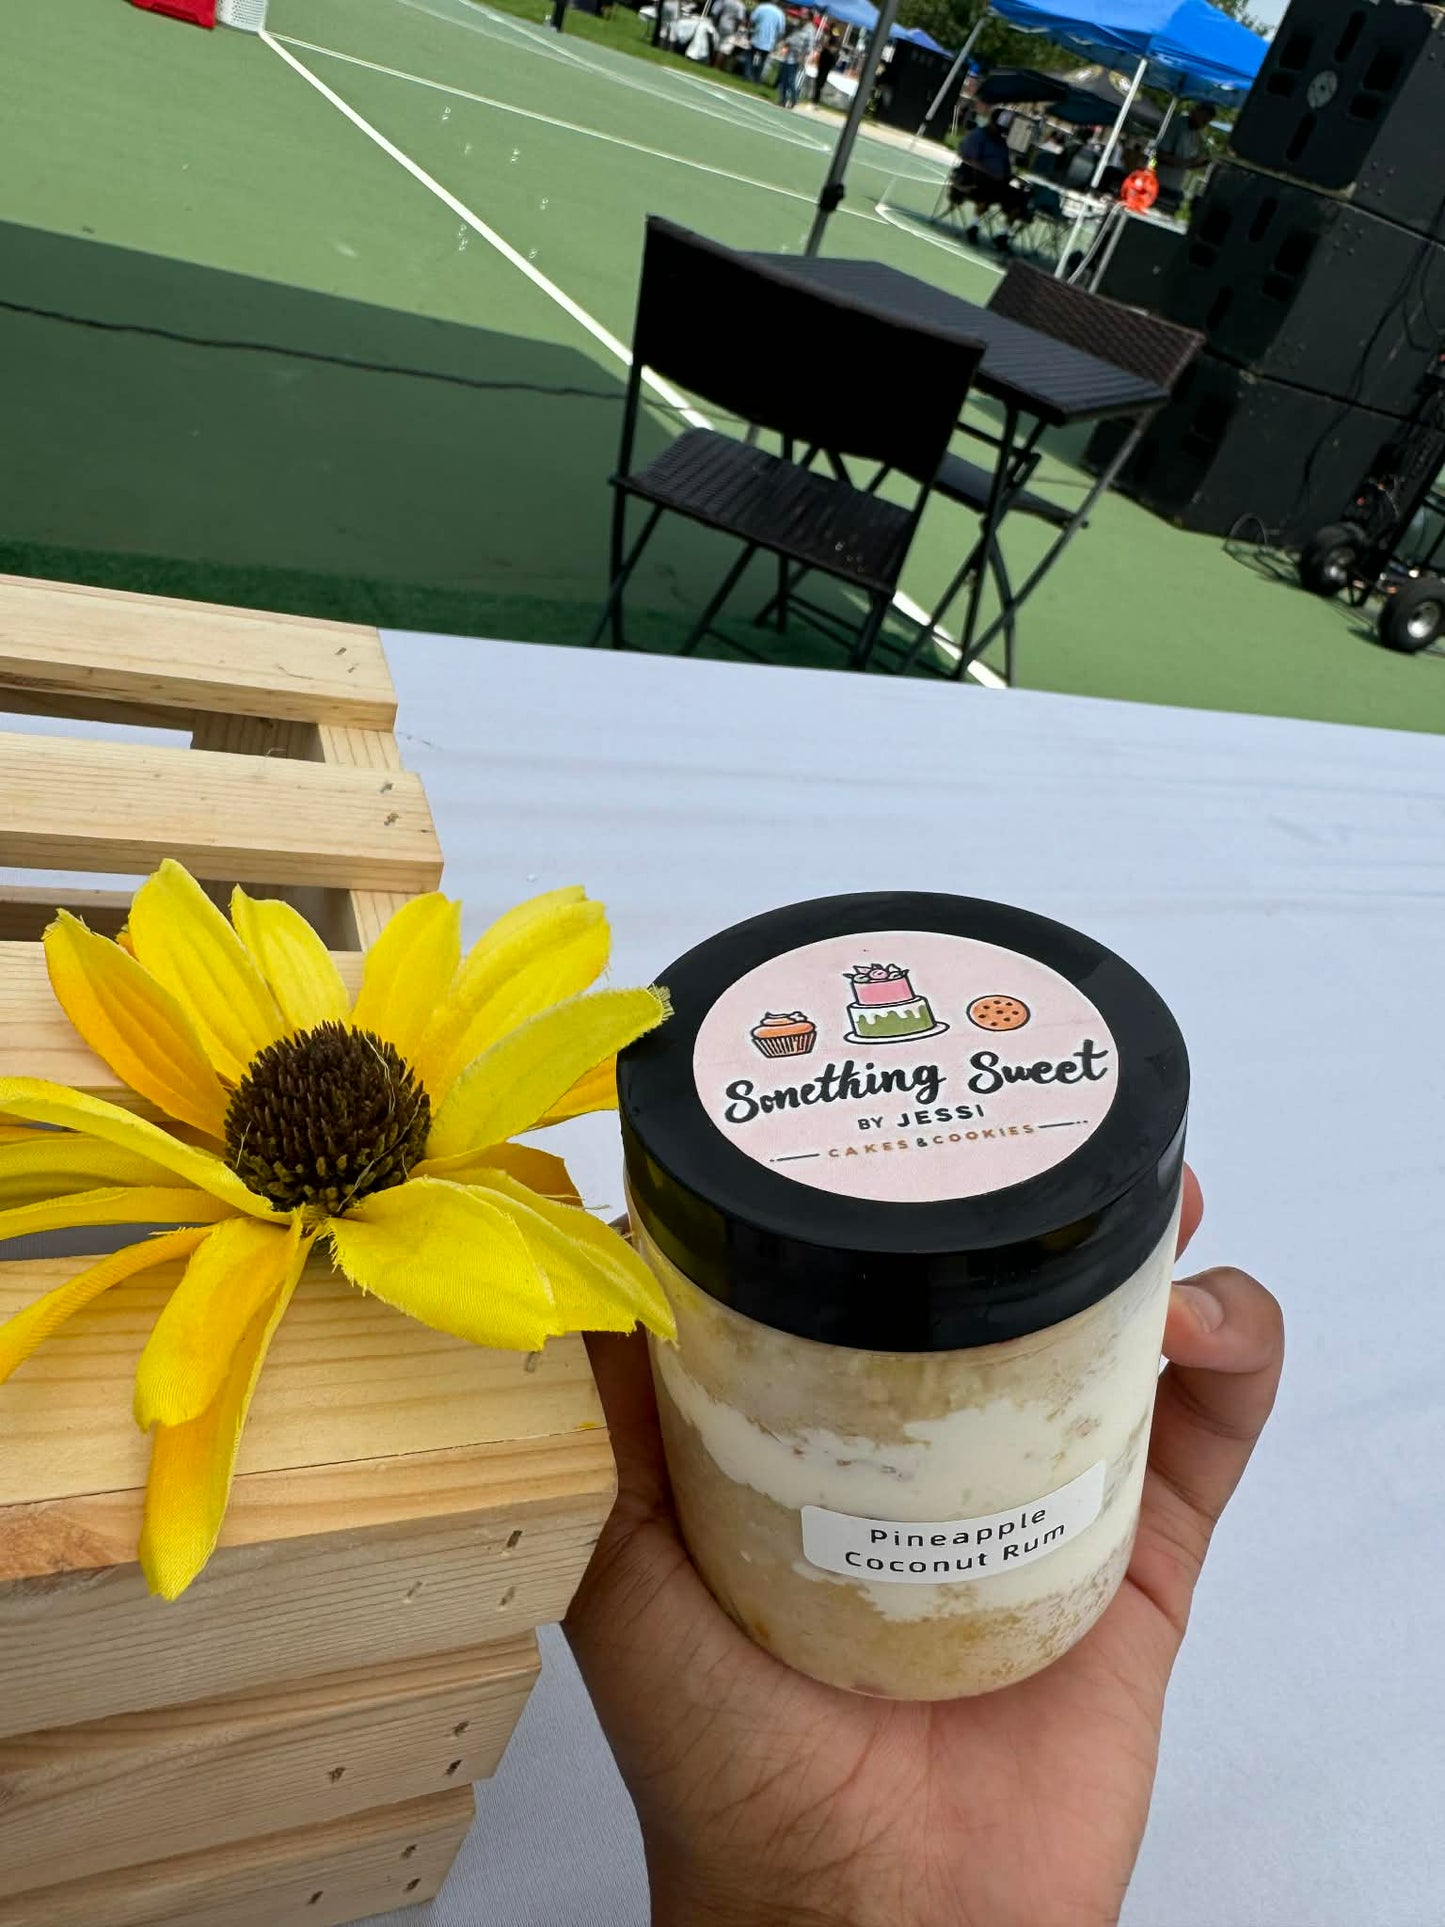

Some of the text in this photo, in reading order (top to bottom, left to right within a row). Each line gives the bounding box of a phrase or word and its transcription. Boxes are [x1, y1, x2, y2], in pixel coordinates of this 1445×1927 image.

[968, 1039, 1109, 1094] Sweet
[857, 1104, 985, 1130] BY JESSI
[845, 1523, 1065, 1573] Coconut Rum
[870, 1508, 1046, 1547] Pineapple
